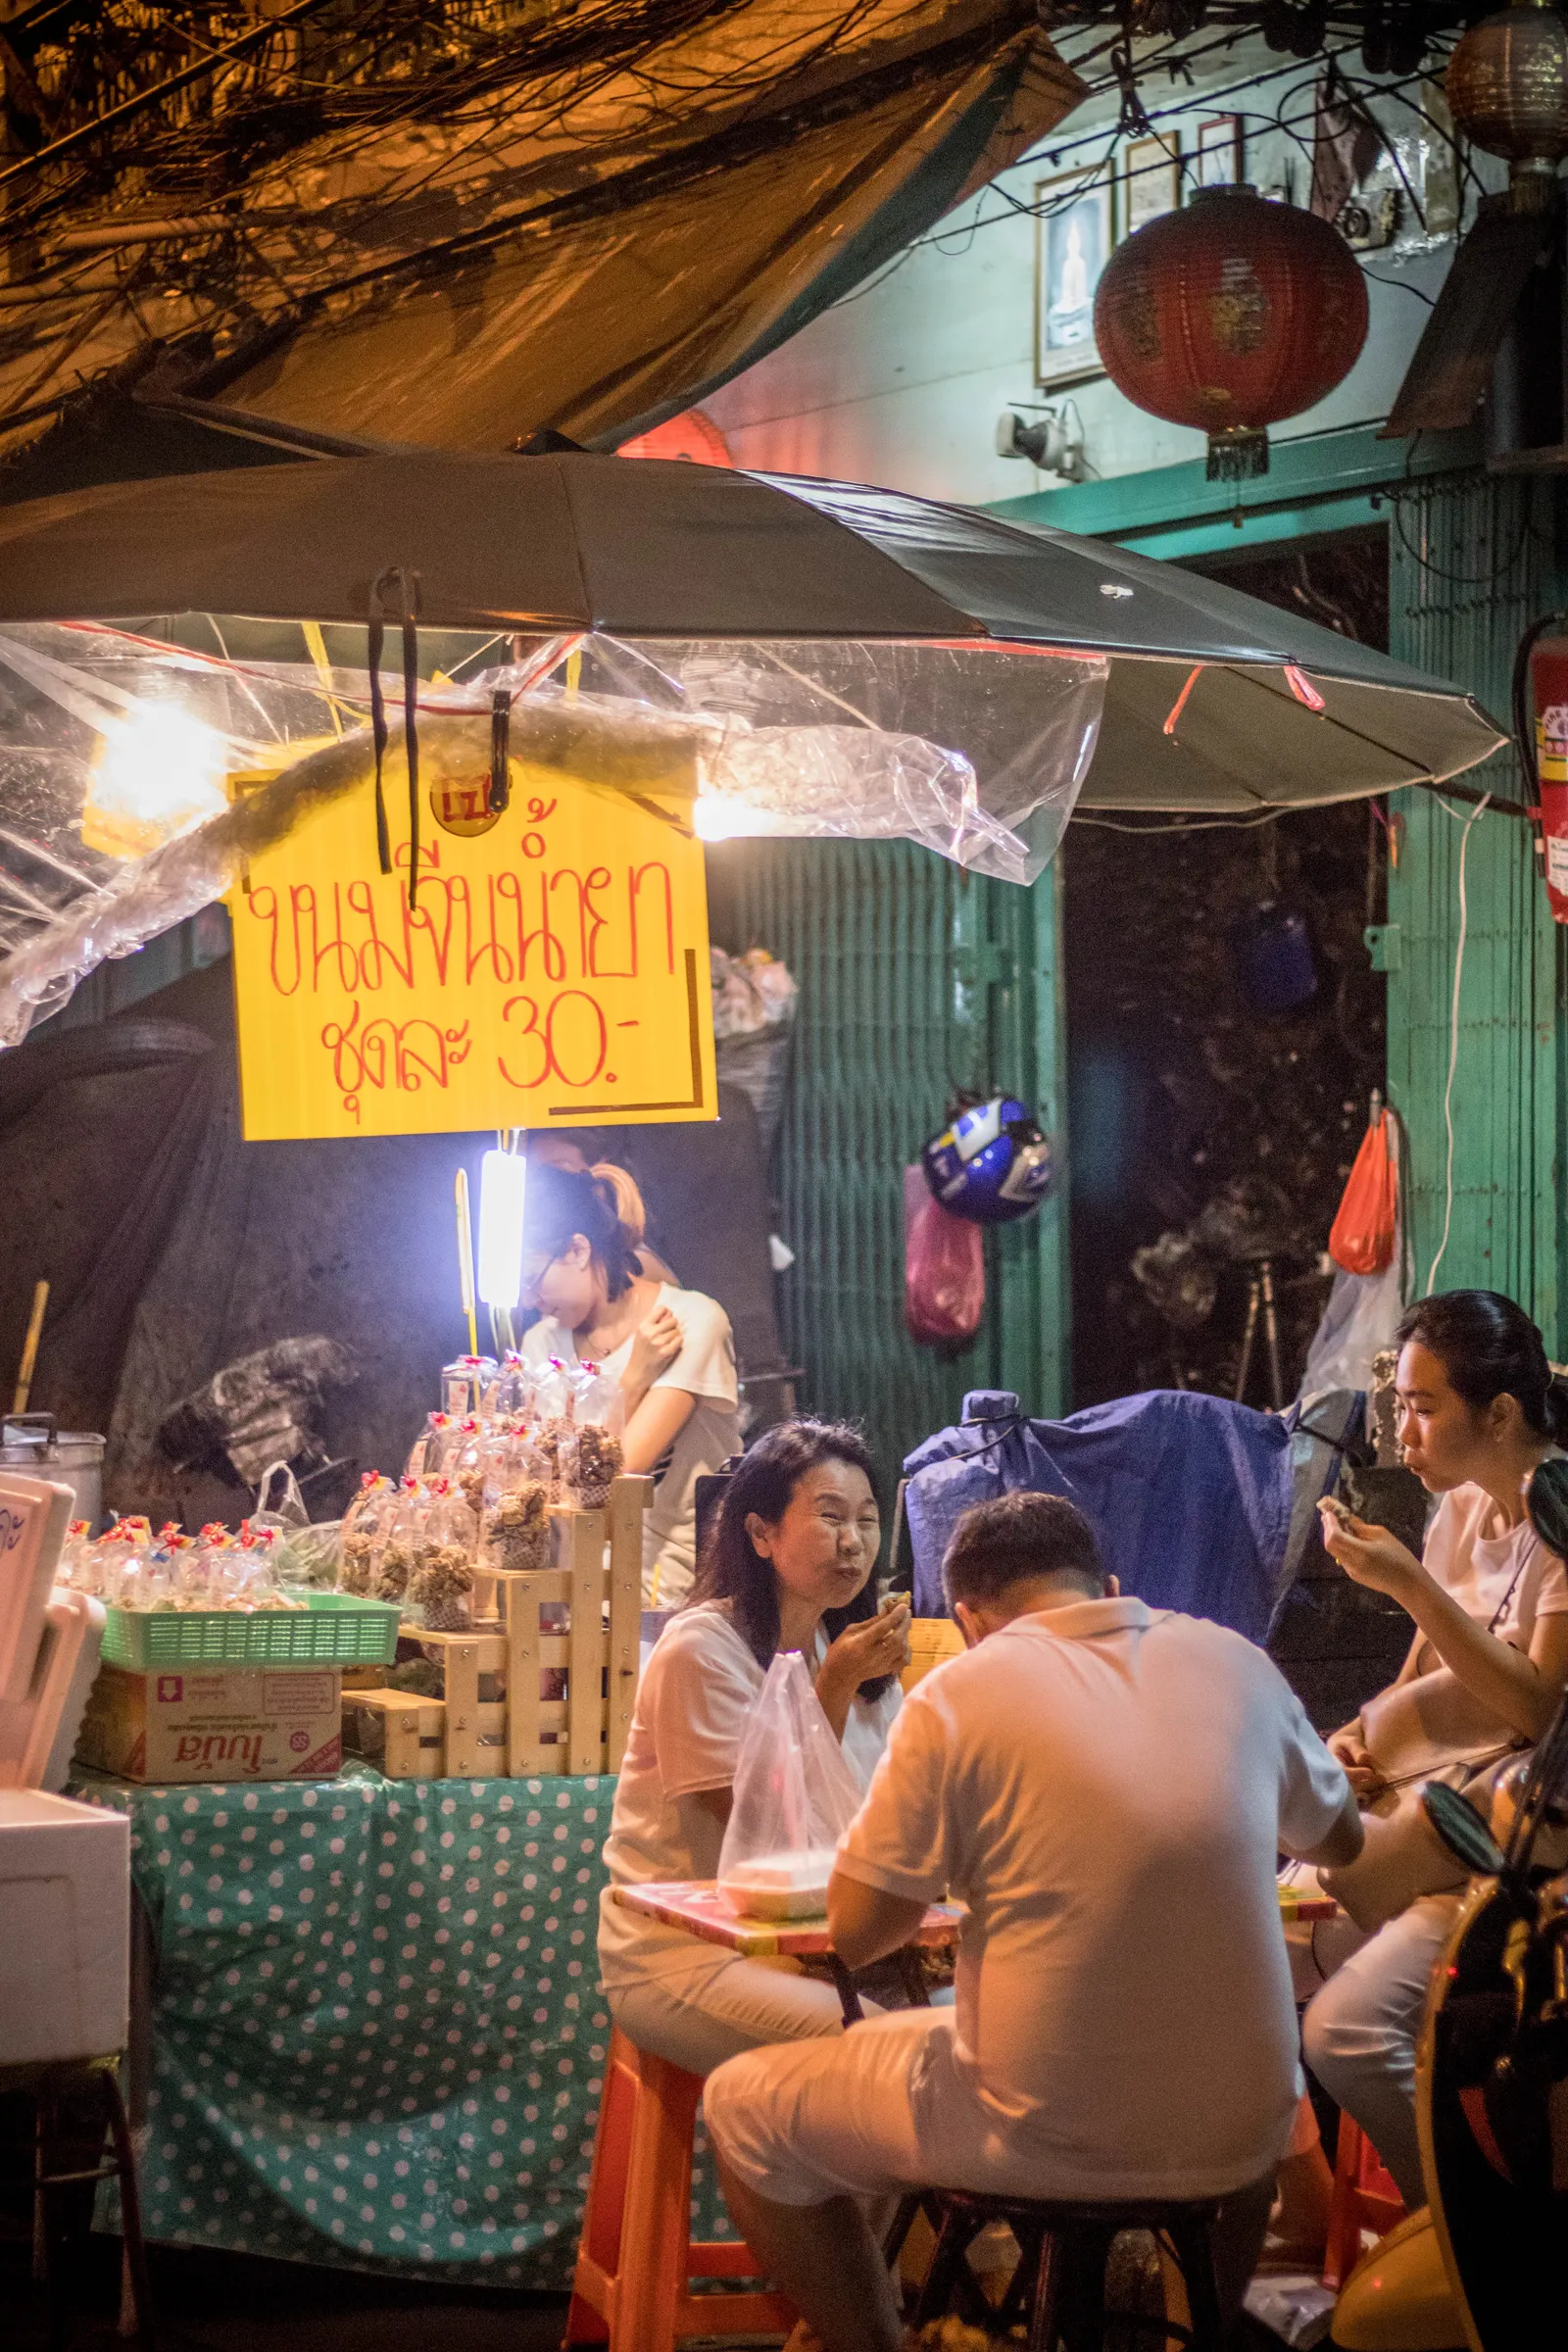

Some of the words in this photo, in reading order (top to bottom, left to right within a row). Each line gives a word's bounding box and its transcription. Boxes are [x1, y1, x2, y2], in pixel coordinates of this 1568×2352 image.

[248, 797, 675, 997] ขนมจีนน้ำยา
[321, 1000, 472, 1125] ชุดละ
[174, 1735, 264, 1775] โบนัส
